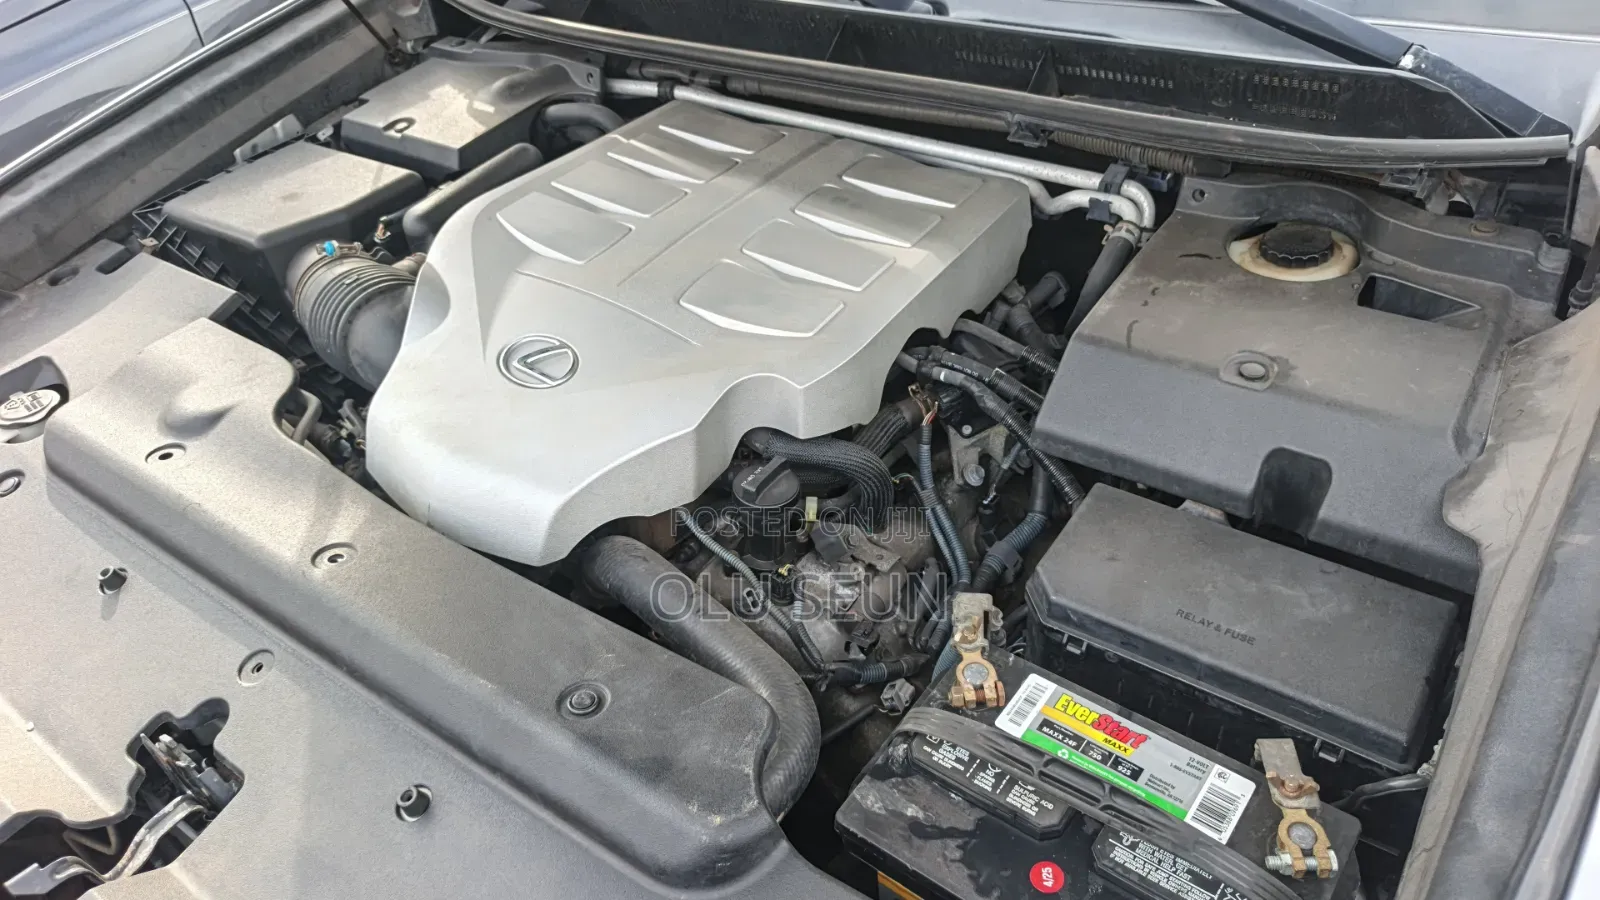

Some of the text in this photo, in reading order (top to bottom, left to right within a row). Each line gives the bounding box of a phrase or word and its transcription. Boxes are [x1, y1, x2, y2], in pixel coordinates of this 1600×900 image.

[1176, 608, 1257, 646] RELAY & FUSE
[1054, 693, 1148, 749] EverStart
[1041, 726, 1078, 748] MAXX 24F
[1102, 737, 1129, 754] MAXX
[938, 747, 956, 760] GASES
[941, 743, 969, 761] EXPLOSIVE
[1088, 749, 1102, 761] 750
[985, 769, 995, 777] NO
[1117, 765, 1132, 776] 925
[1186, 761, 1207, 775] Battery
[1040, 799, 1054, 810] ACID
[1135, 847, 1192, 881] MEDICAL HELP FAST
[1137, 842, 1154, 854] WITH
[1175, 862, 1188, 872] GET
[1041, 867, 1055, 888] 4/25
